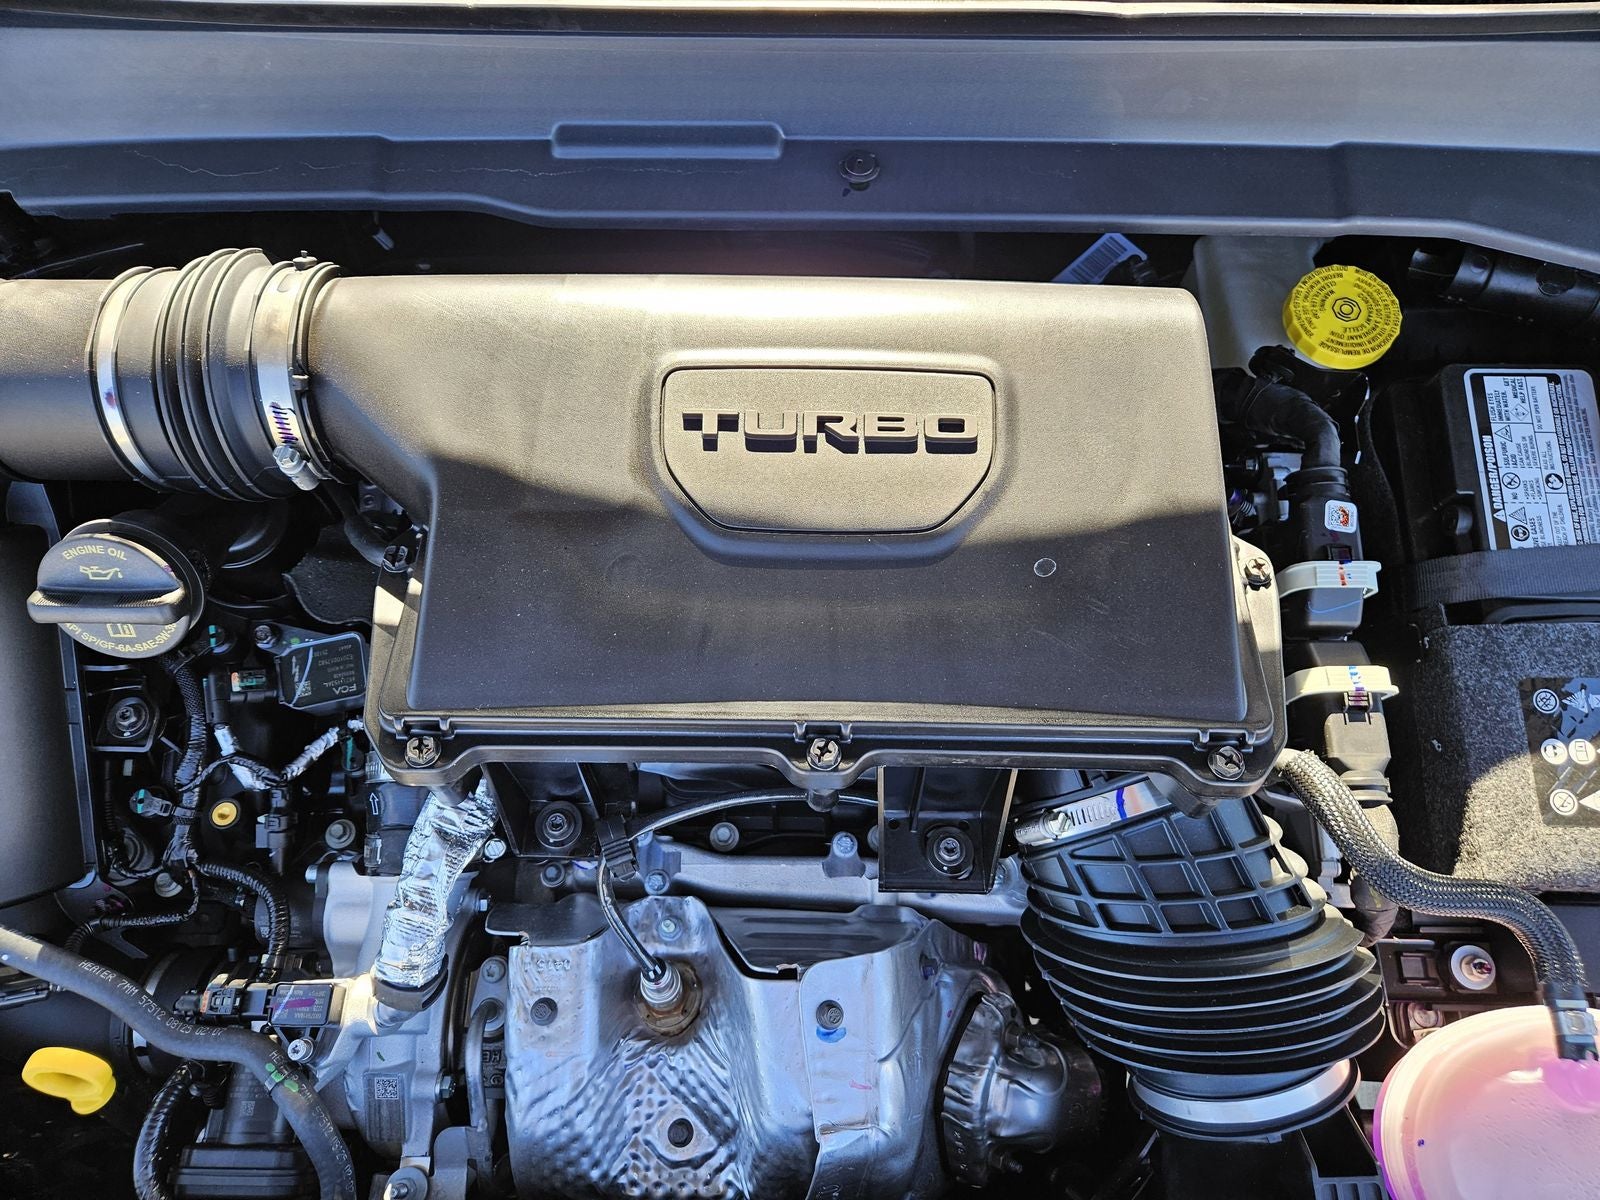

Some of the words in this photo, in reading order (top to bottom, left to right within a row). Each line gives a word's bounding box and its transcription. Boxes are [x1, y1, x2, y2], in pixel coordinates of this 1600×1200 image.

[1319, 273, 1343, 282] BEFORE
[1356, 276, 1376, 289] AVANT
[1319, 289, 1335, 311] WARNING
[1510, 378, 1518, 398] MEDICAL
[1494, 390, 1503, 421] IMMEDIATELY
[682, 408, 979, 453] TURBO
[1500, 442, 1510, 466] SULFURIC
[1515, 443, 1523, 456] CAUSE
[1523, 443, 1531, 466] BLINDNESS
[1565, 438, 1573, 455] PROPER
[1482, 435, 1502, 509] DANGER/POISON
[1537, 516, 1545, 539] BLINDNESS
[62, 545, 104, 559] ENGINE
[108, 548, 127, 560] OIL
[332, 683, 357, 695] FCA
[78, 960, 116, 982] HEATER
[117, 979, 139, 996] 7MM
[138, 994, 166, 1021] 57512
